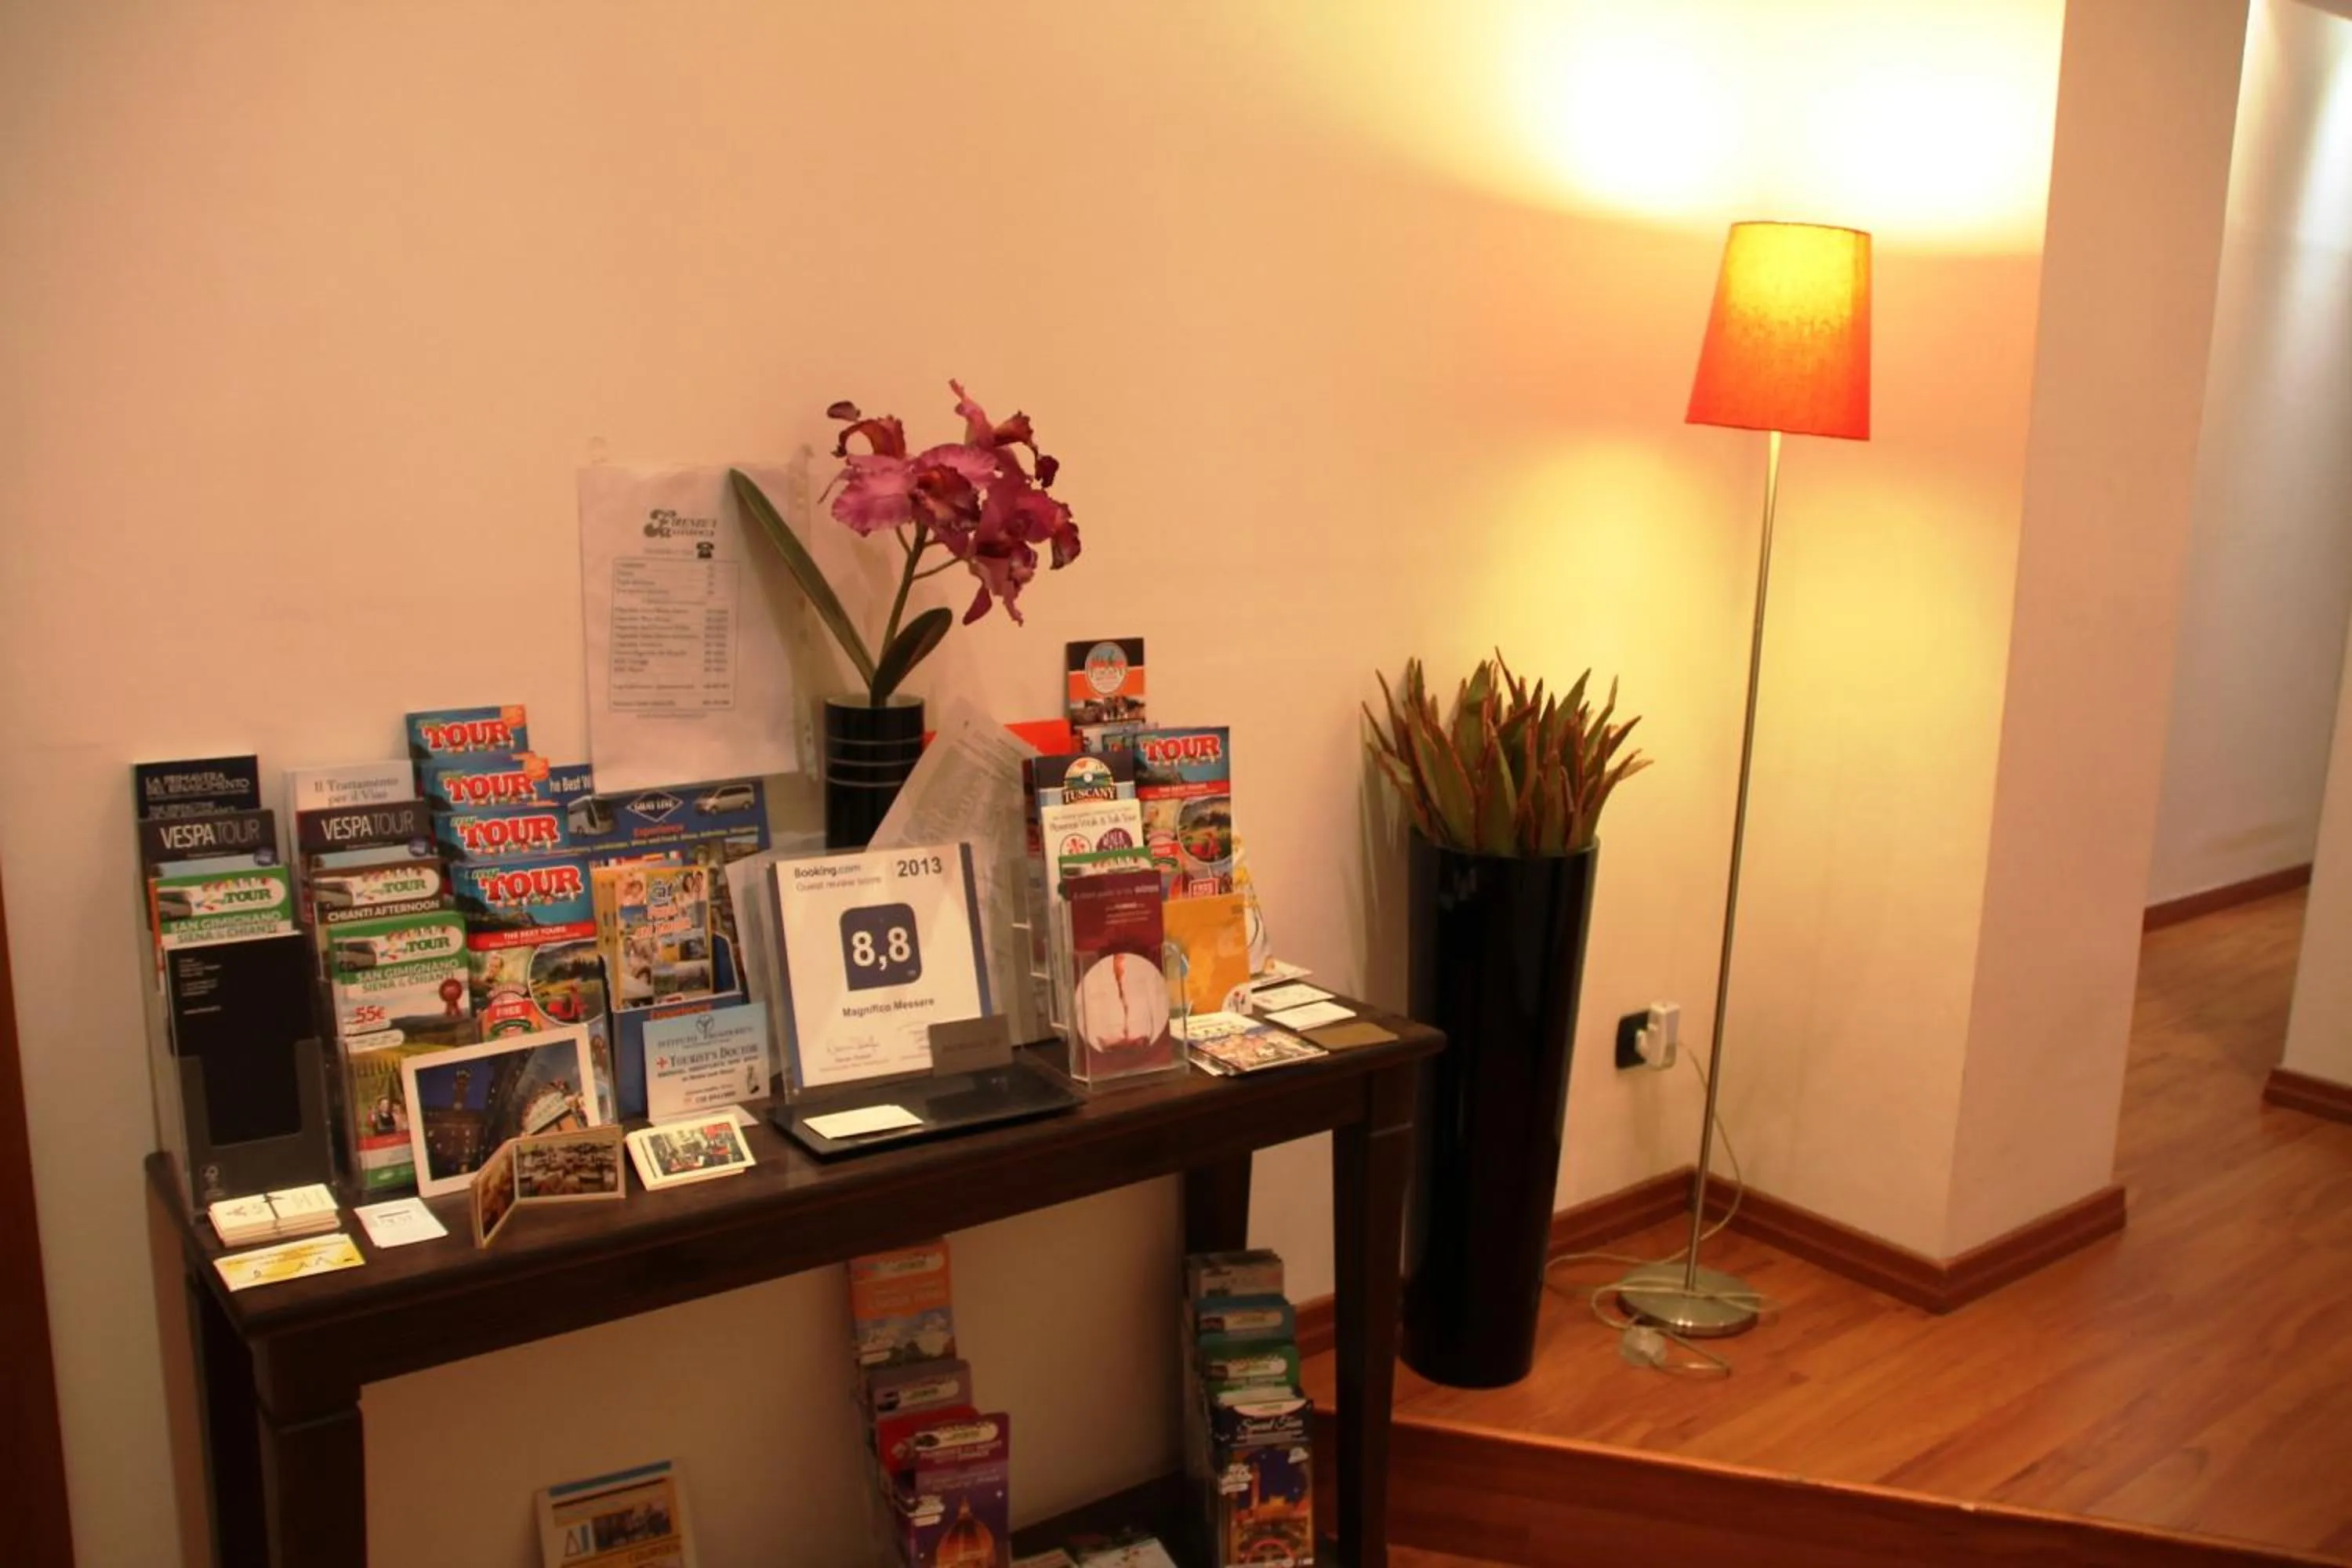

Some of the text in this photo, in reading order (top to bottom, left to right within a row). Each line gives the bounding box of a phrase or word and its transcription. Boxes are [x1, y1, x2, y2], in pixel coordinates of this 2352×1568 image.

[423, 720, 513, 750] TOUR
[1143, 735, 1221, 762] TOUR
[445, 772, 535, 802] TOUR
[1063, 786, 1115, 804] TUSCANY
[459, 816, 559, 848] TOUR
[794, 856, 942, 879] Booking.com 2013
[225, 888, 271, 903] TOUR
[383, 879, 426, 893] TOUR
[480, 866, 583, 902] TOUR
[328, 900, 440, 922] CHIANTI AFTERNOON
[406, 937, 451, 952] TOUR
[851, 926, 912, 971] 8,8
